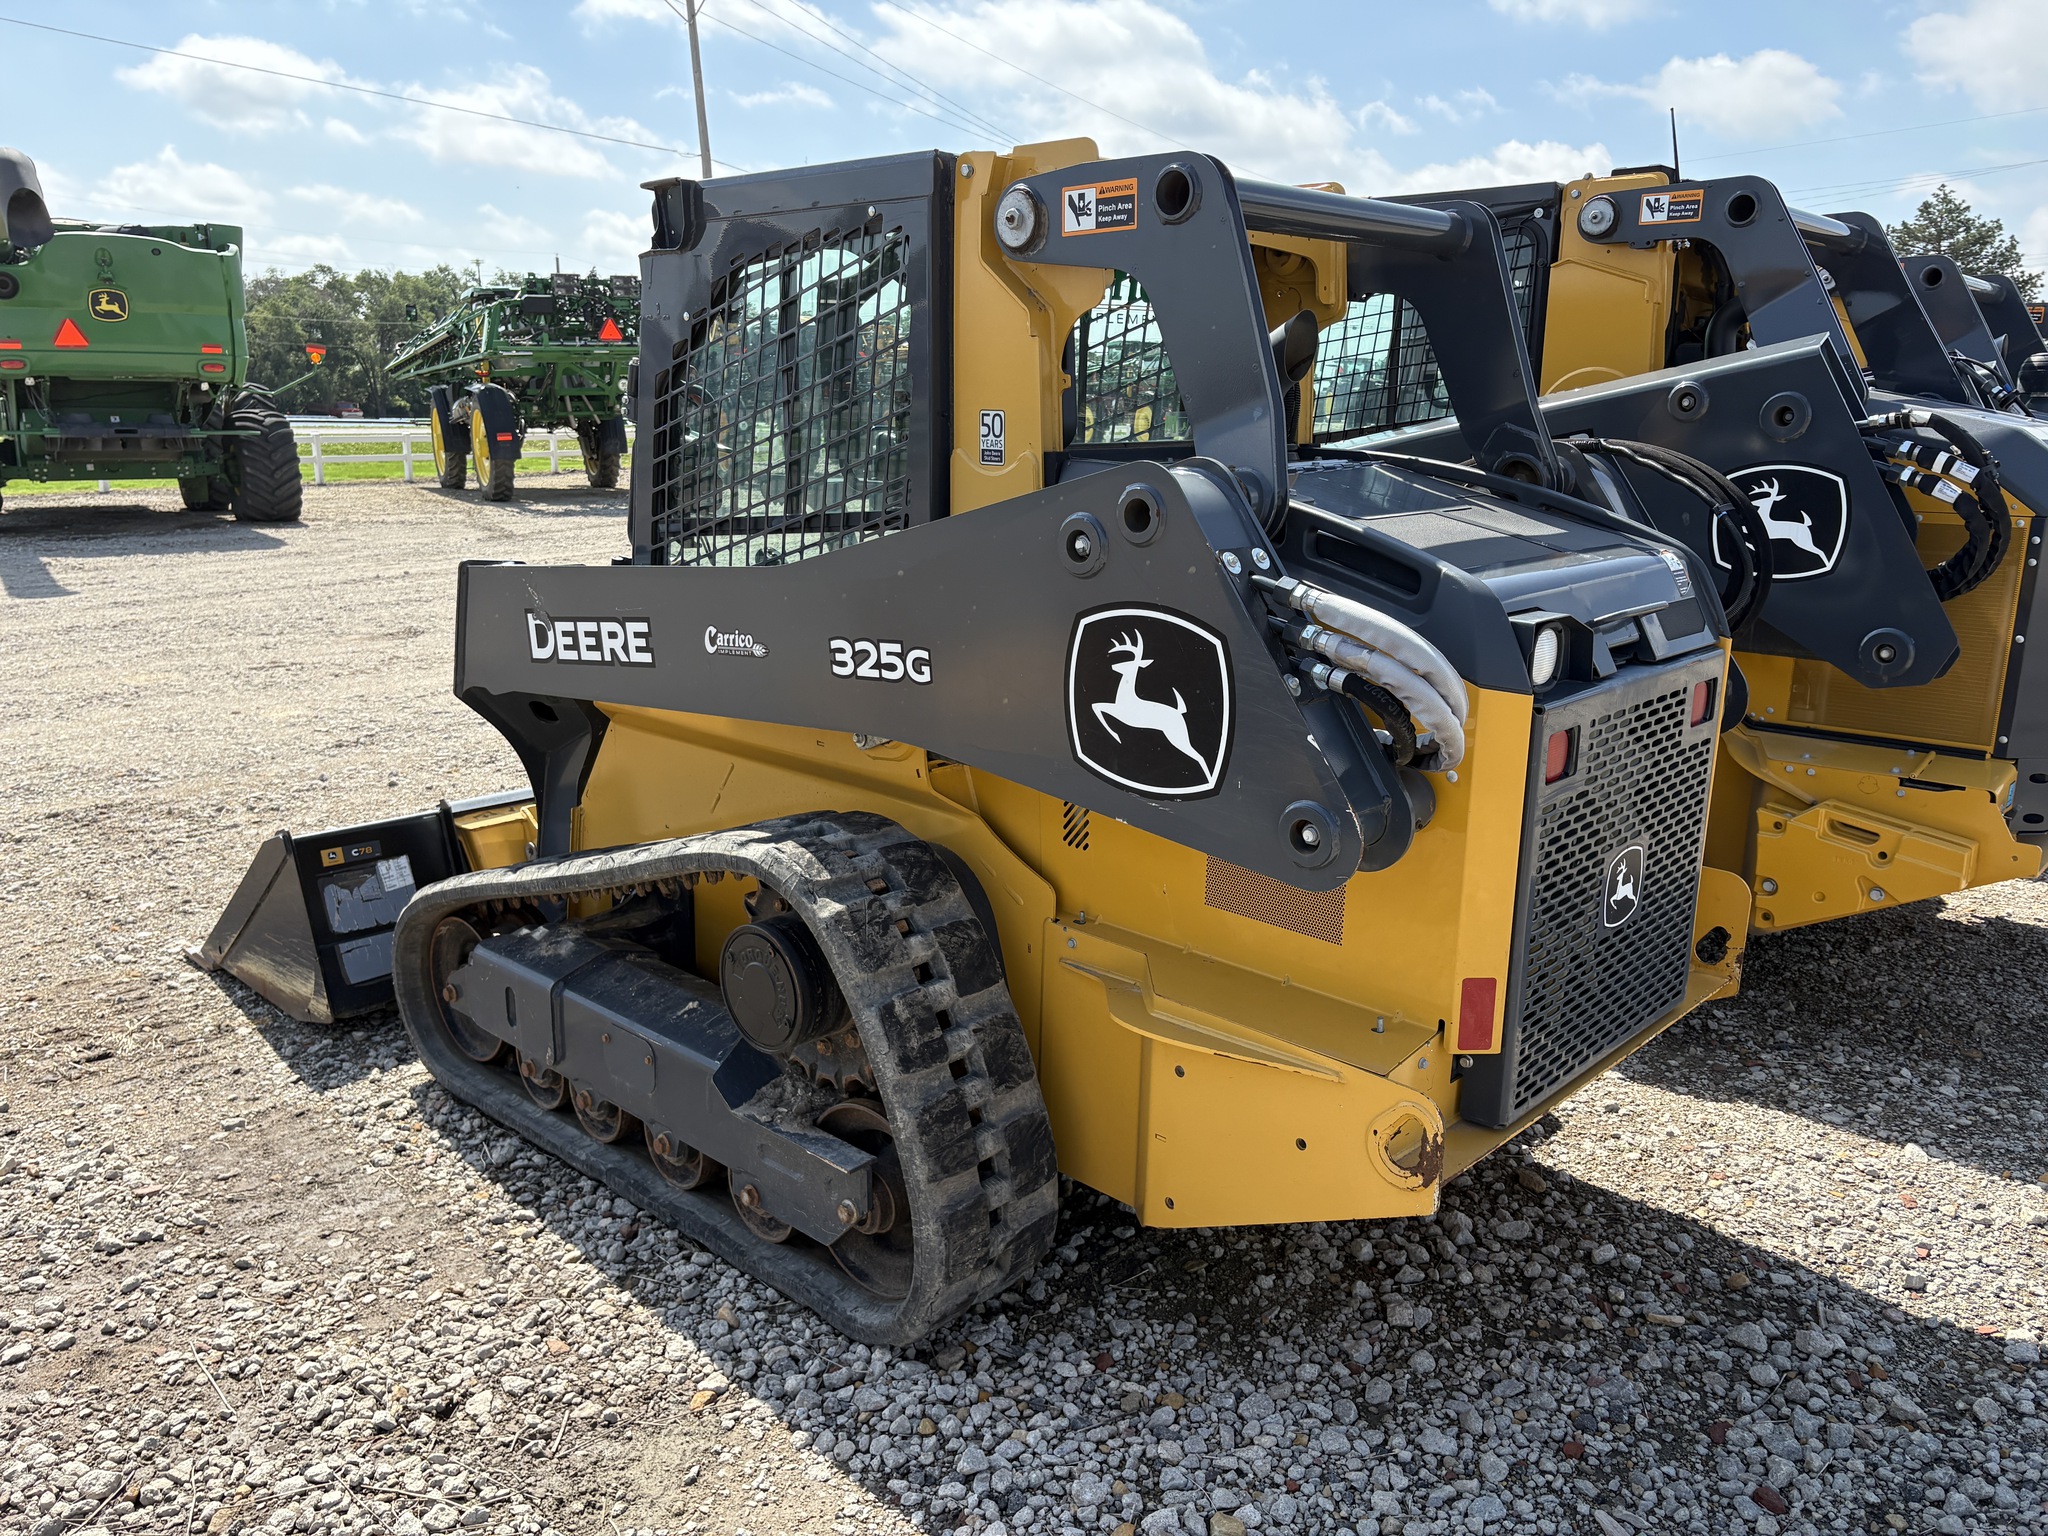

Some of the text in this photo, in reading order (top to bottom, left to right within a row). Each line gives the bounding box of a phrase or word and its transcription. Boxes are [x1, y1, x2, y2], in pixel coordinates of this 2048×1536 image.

[1105, 184, 1133, 193] WARNING
[1098, 202, 1132, 213] Pinch Area
[1113, 213, 1128, 221] Away
[981, 413, 1003, 438] 50
[981, 438, 1003, 449] YEARS
[526, 613, 653, 664] DEERE
[704, 625, 753, 654] Carrico
[829, 639, 932, 684] 325G
